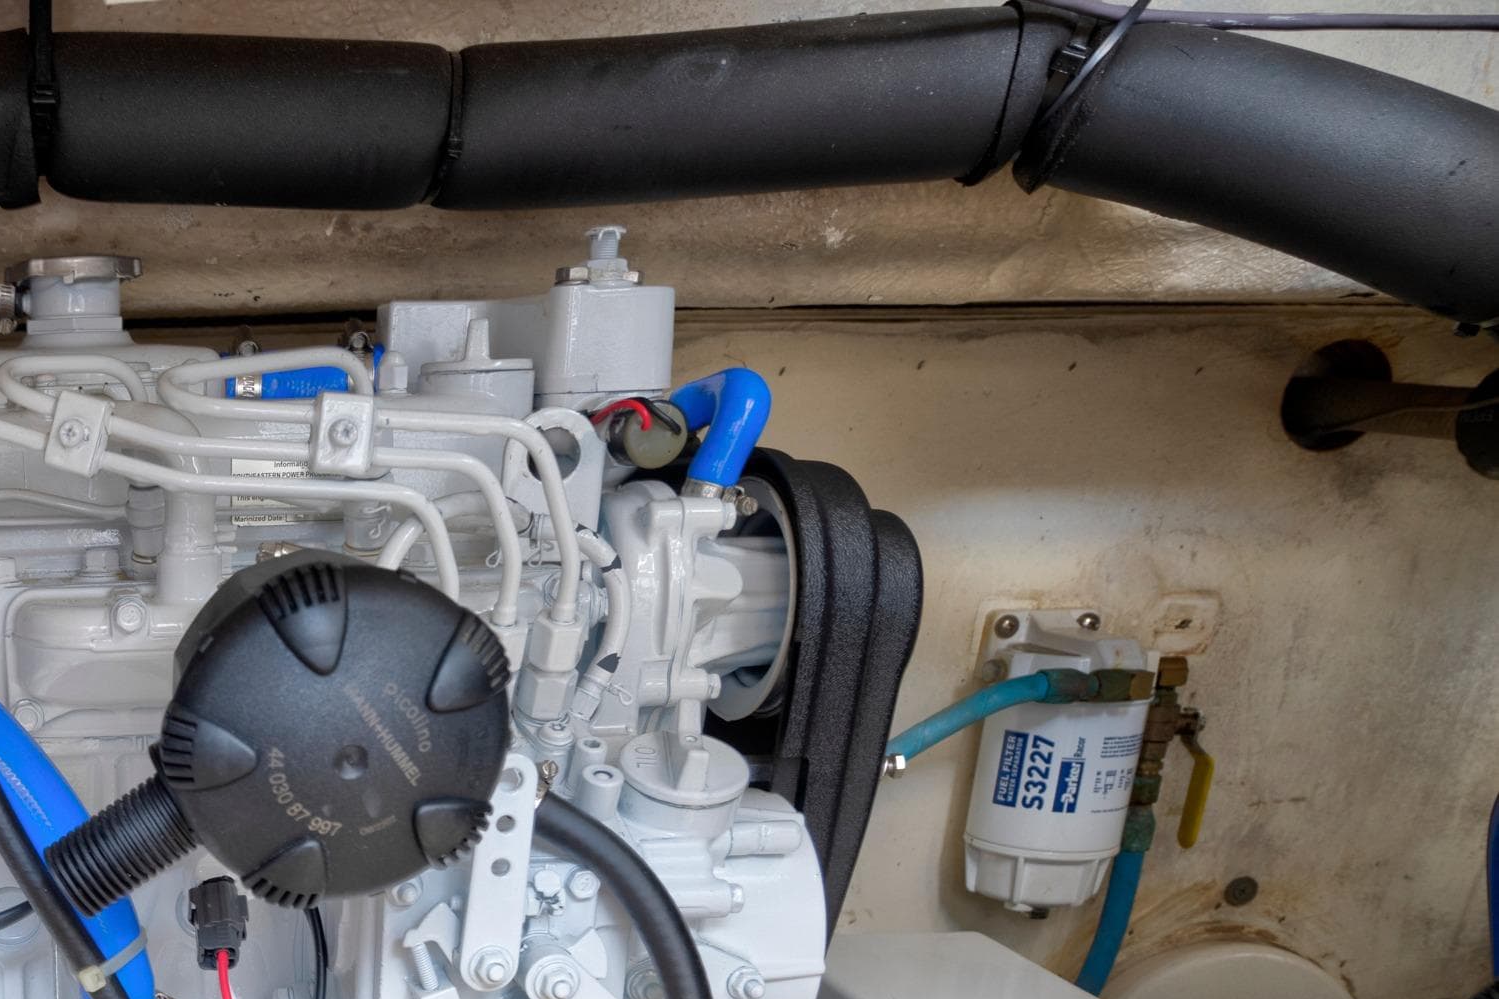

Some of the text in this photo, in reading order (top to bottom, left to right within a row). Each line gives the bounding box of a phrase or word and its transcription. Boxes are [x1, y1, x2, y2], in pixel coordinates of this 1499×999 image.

[268, 747, 344, 838] 44 030 87 997
[996, 734, 1018, 802] FUEL FILTER
[1021, 734, 1055, 811] S3227
[1060, 761, 1084, 810] Parker
